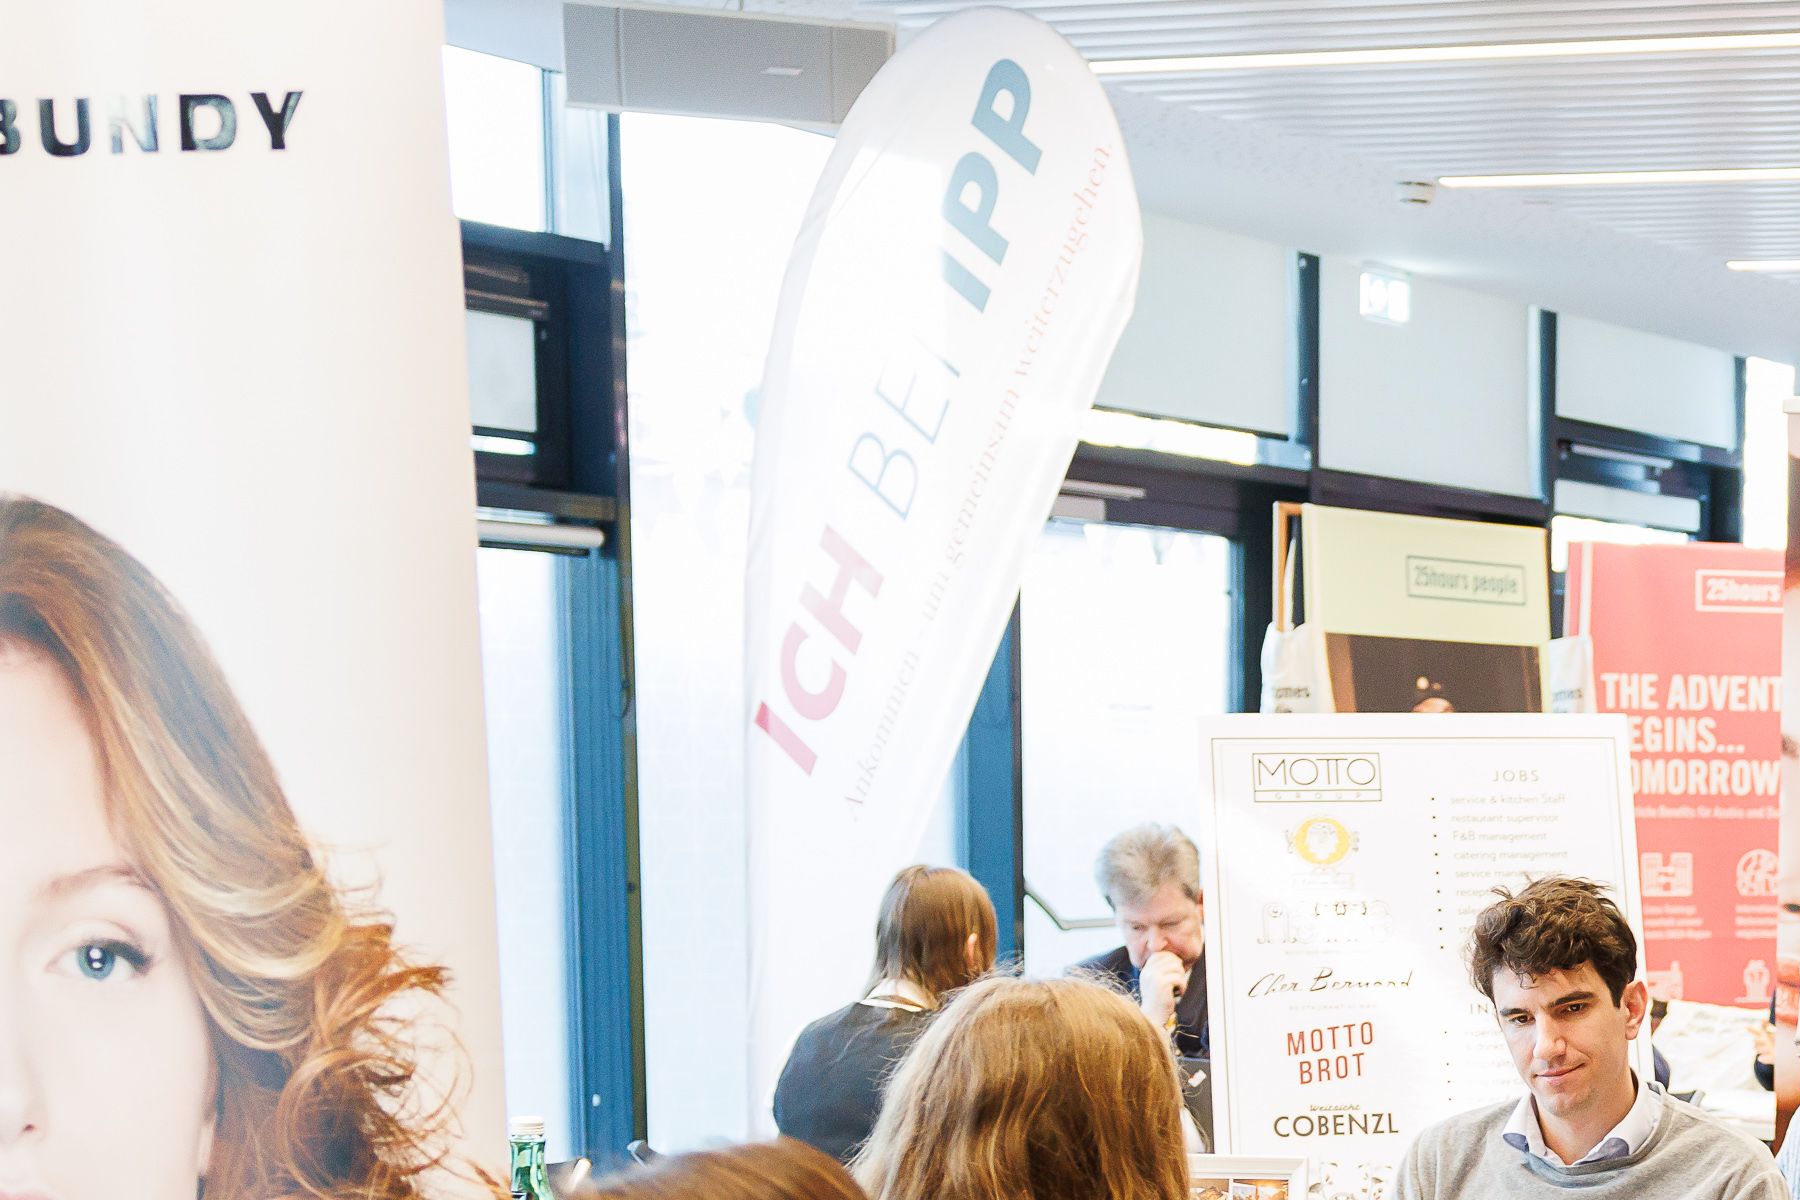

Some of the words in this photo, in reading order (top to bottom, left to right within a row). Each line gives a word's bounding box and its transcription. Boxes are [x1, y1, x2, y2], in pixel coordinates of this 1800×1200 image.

[754, 524, 885, 777] ICH
[847, 336, 961, 521] BEI
[940, 58, 1044, 313] IPP
[1414, 560, 1468, 591] 25hours
[1472, 569, 1519, 597] people
[1705, 577, 1782, 602] 25hours
[844, 650, 921, 823] Ankommen
[946, 388, 1021, 568] gemeinsam
[1601, 672, 1659, 709] THE
[1630, 715, 1745, 753] EGINS...
[1257, 758, 1376, 786] MOTTO
[1492, 769, 1540, 783] JOBS
[1631, 758, 1781, 796] OMORROW
[1274, 791, 1363, 801] GROUP
[1450, 795, 1486, 805] service
[1500, 793, 1538, 805] kitchen
[1451, 813, 1504, 823] restaurant
[1506, 814, 1560, 825] supervisor
[1479, 831, 1548, 844] management
[1454, 849, 1497, 862] catering
[1499, 849, 1569, 862] management
[1455, 868, 1492, 879] service
[1287, 1021, 1374, 1057] MOTTO
[1299, 1053, 1365, 1086] BROT
[1274, 1113, 1399, 1138] COBENZL
